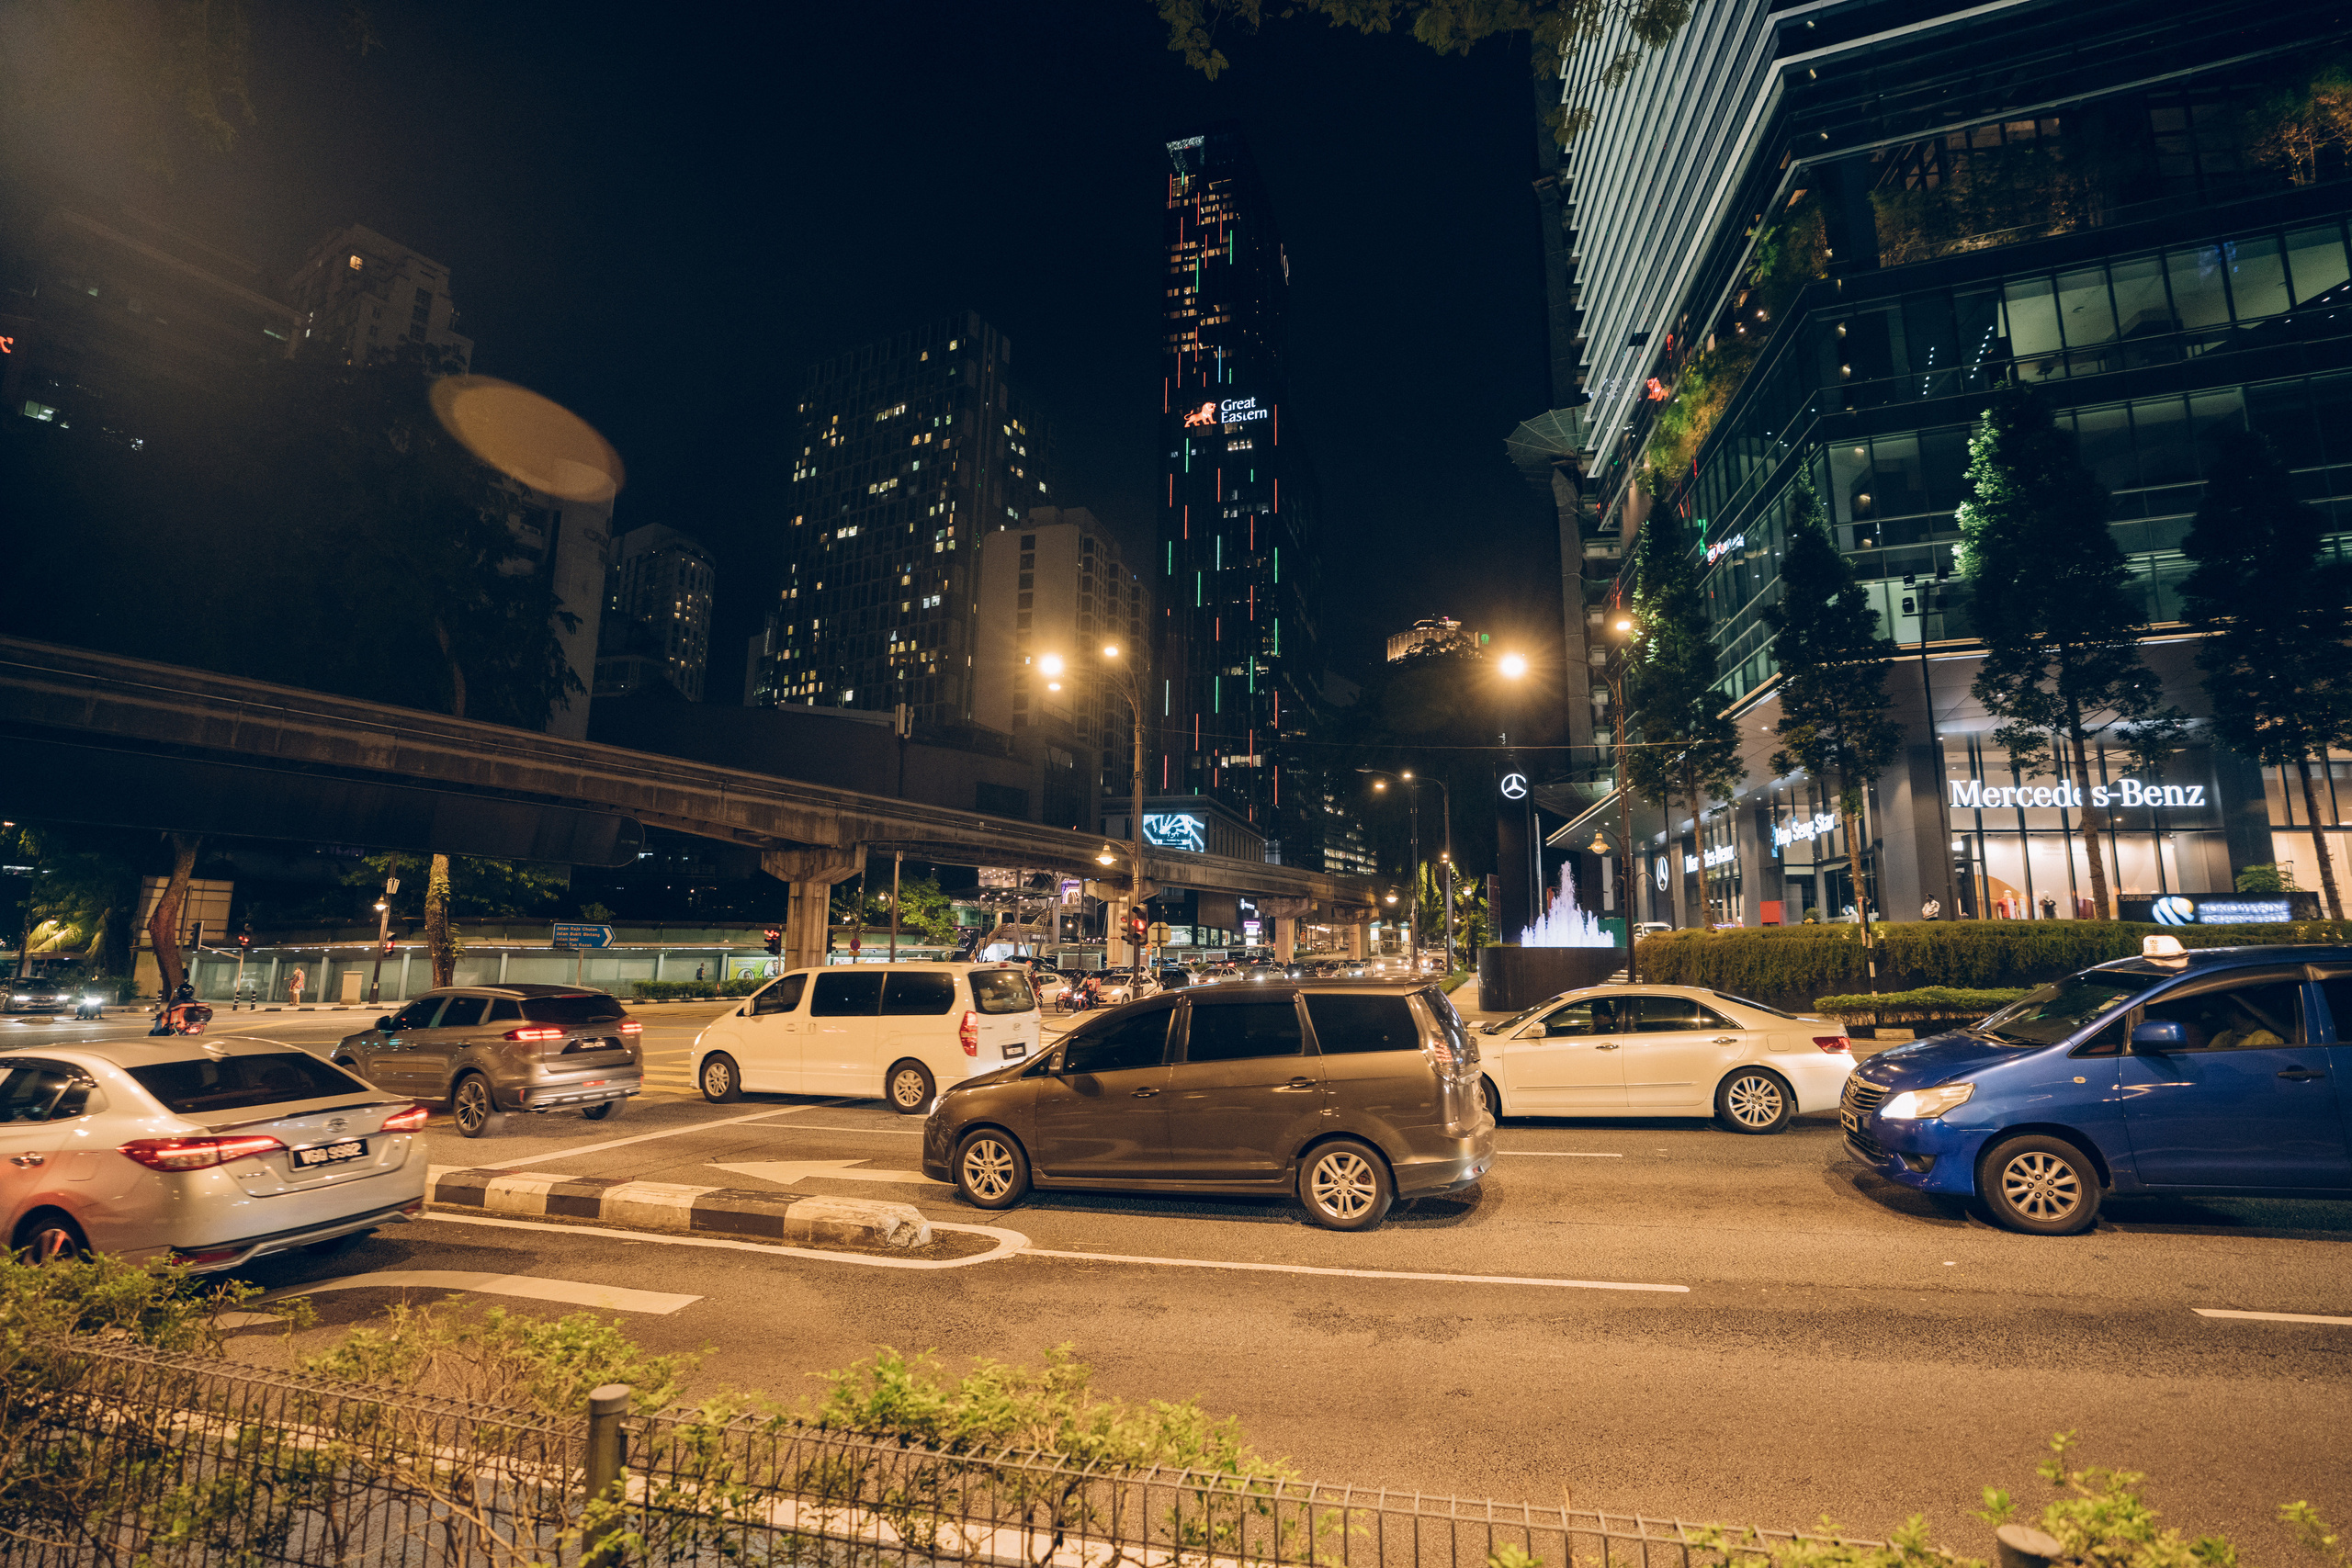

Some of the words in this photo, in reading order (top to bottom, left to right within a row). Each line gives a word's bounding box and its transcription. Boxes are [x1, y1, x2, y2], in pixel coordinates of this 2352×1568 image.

[1221, 397, 1256, 412] Great
[1221, 409, 1267, 423] Eastern
[1775, 828, 1792, 848] Hap
[1792, 821, 1815, 840] Seng
[1815, 813, 1836, 834] Star
[1685, 845, 1735, 873] Merdes-Benz
